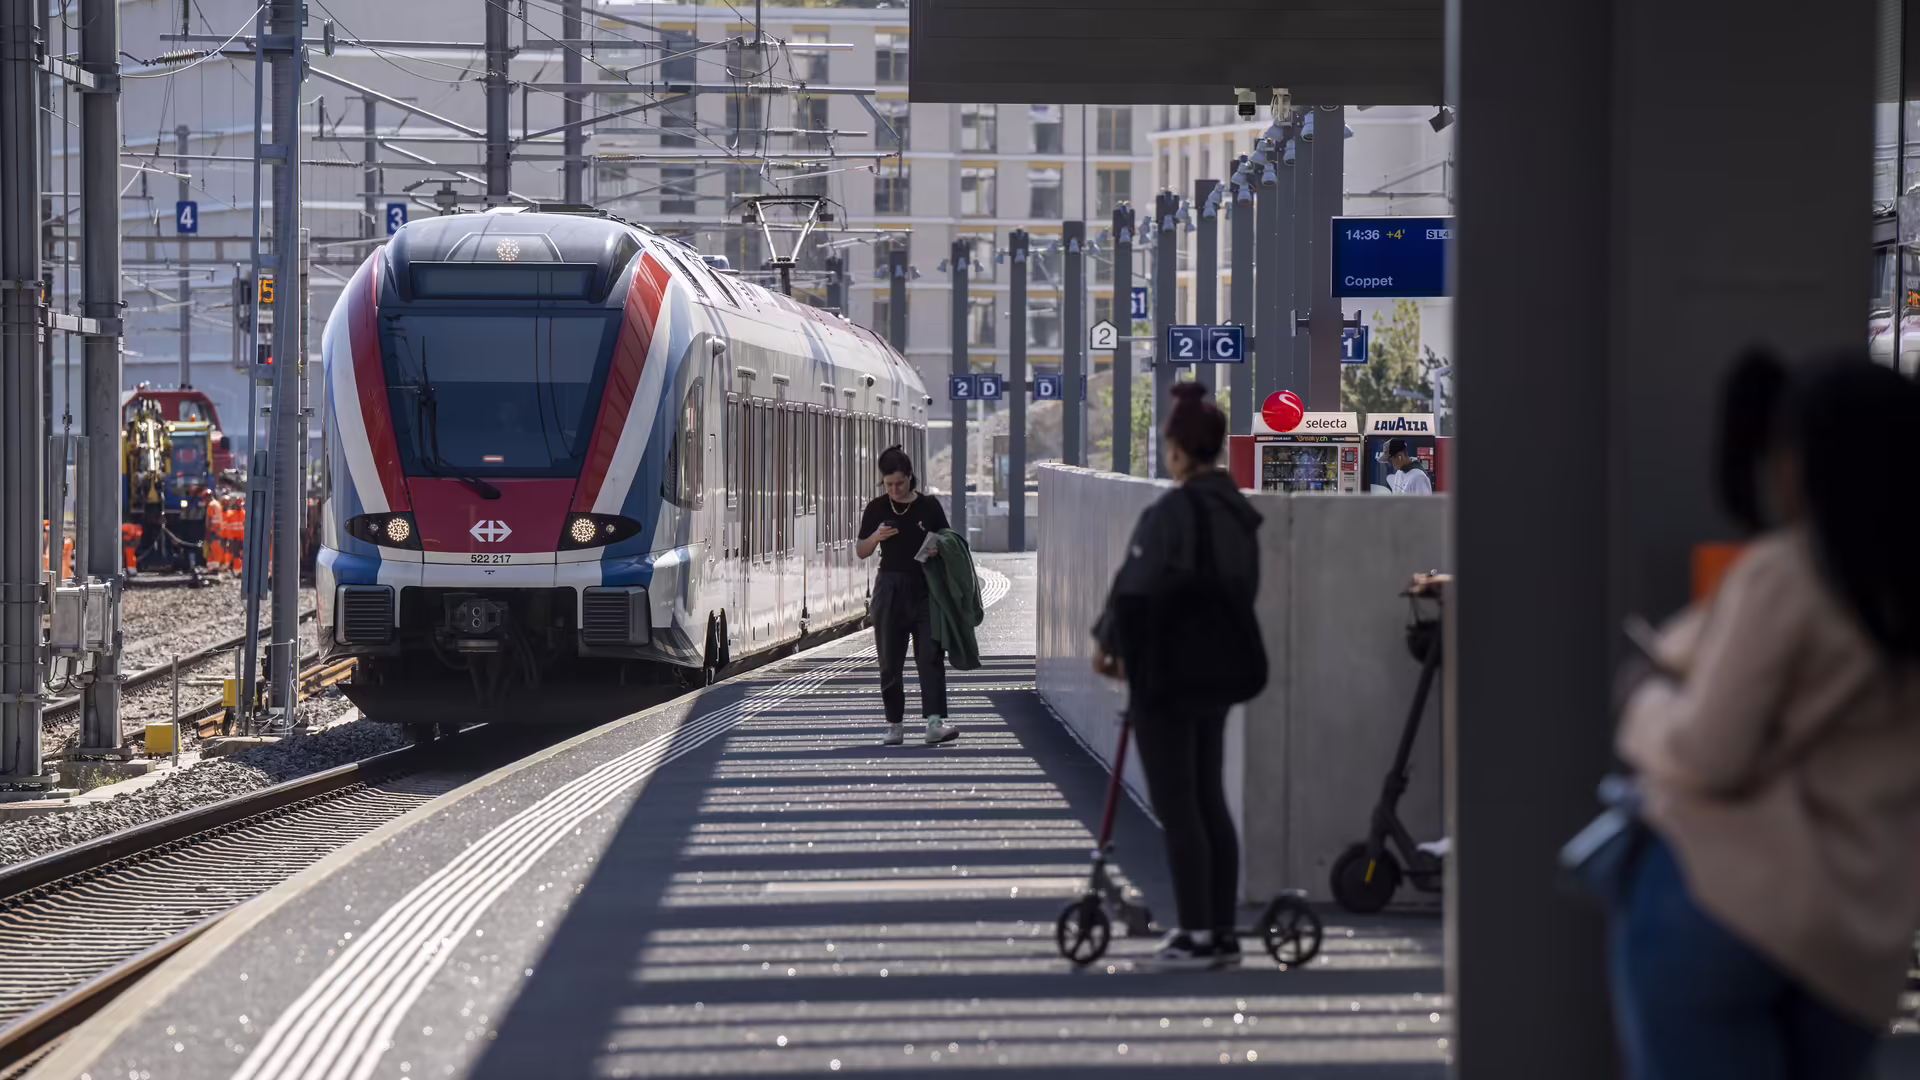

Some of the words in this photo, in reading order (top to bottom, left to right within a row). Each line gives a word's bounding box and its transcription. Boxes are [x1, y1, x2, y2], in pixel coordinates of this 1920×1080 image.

[180, 205, 193, 229] 4
[391, 207, 403, 230] 3
[1345, 229, 1380, 240] 14:36
[1344, 275, 1393, 288] Coppet
[1098, 327, 1111, 345] 2
[1179, 337, 1193, 357] 2
[1216, 337, 1235, 357] C
[1343, 338, 1353, 357] 1
[957, 381, 969, 396] 2
[983, 381, 996, 396] D
[1040, 382, 1053, 396] D
[1305, 418, 1347, 429] selecta
[1374, 416, 1428, 431] LAVAZZA
[470, 554, 490, 563] 522
[492, 554, 512, 563] 217
